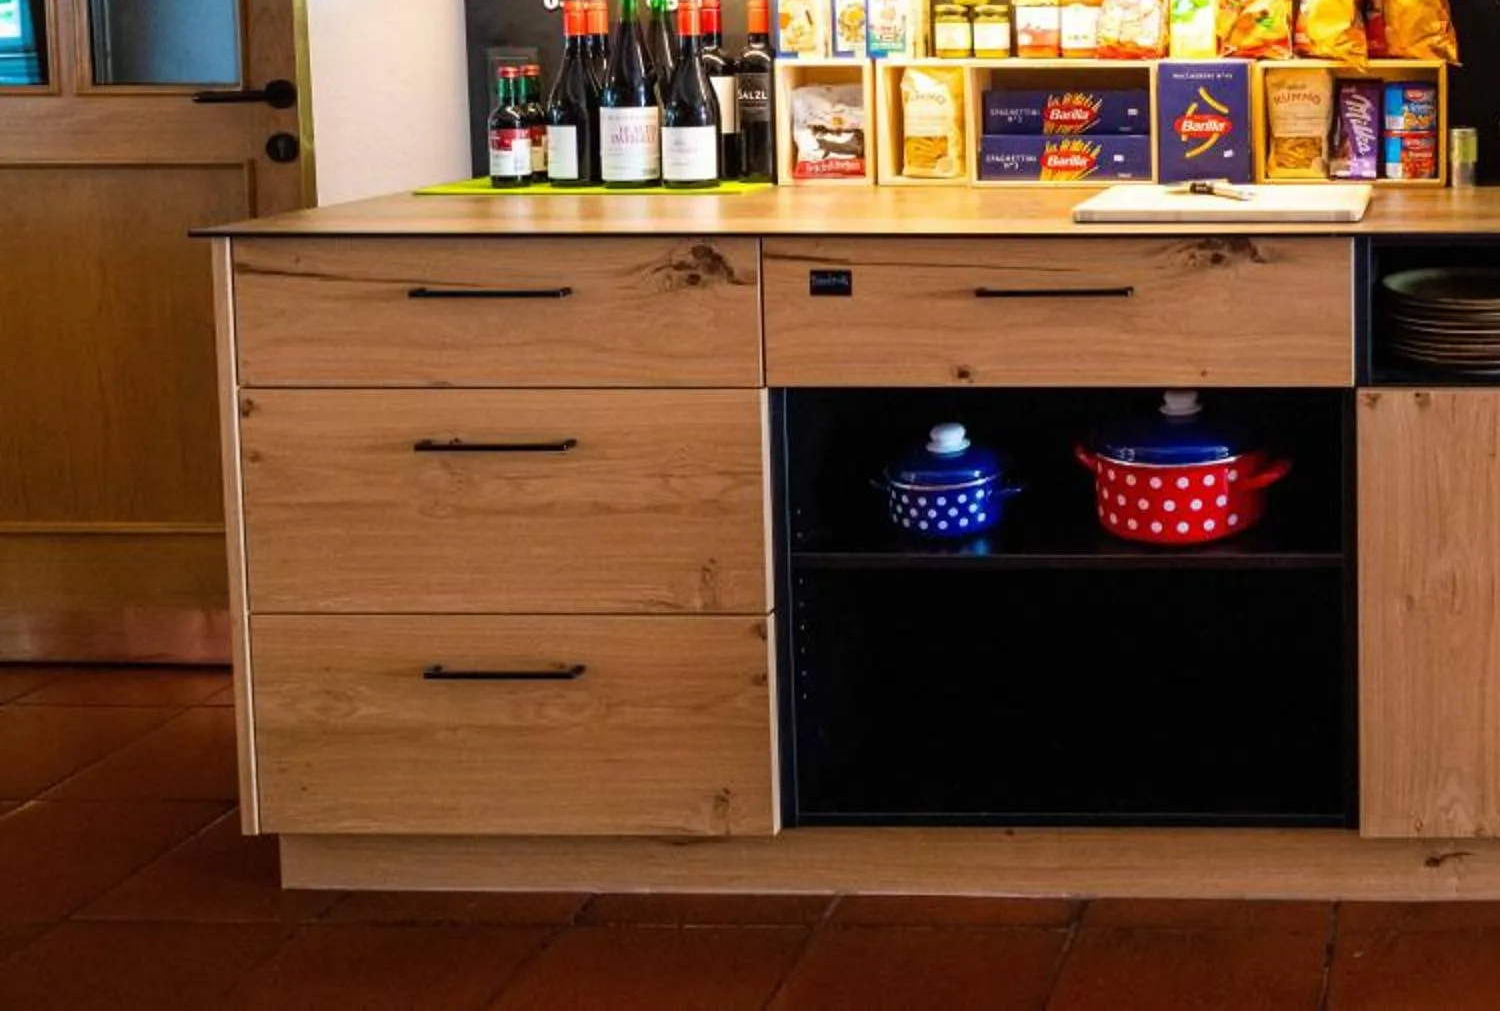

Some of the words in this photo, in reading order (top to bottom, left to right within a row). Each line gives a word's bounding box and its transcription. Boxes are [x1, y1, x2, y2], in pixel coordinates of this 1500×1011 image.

[1049, 108, 1091, 121] Barilla
[1181, 119, 1227, 134] Barilla
[1345, 93, 1377, 157] Milka
[1047, 155, 1089, 167] Barilla
